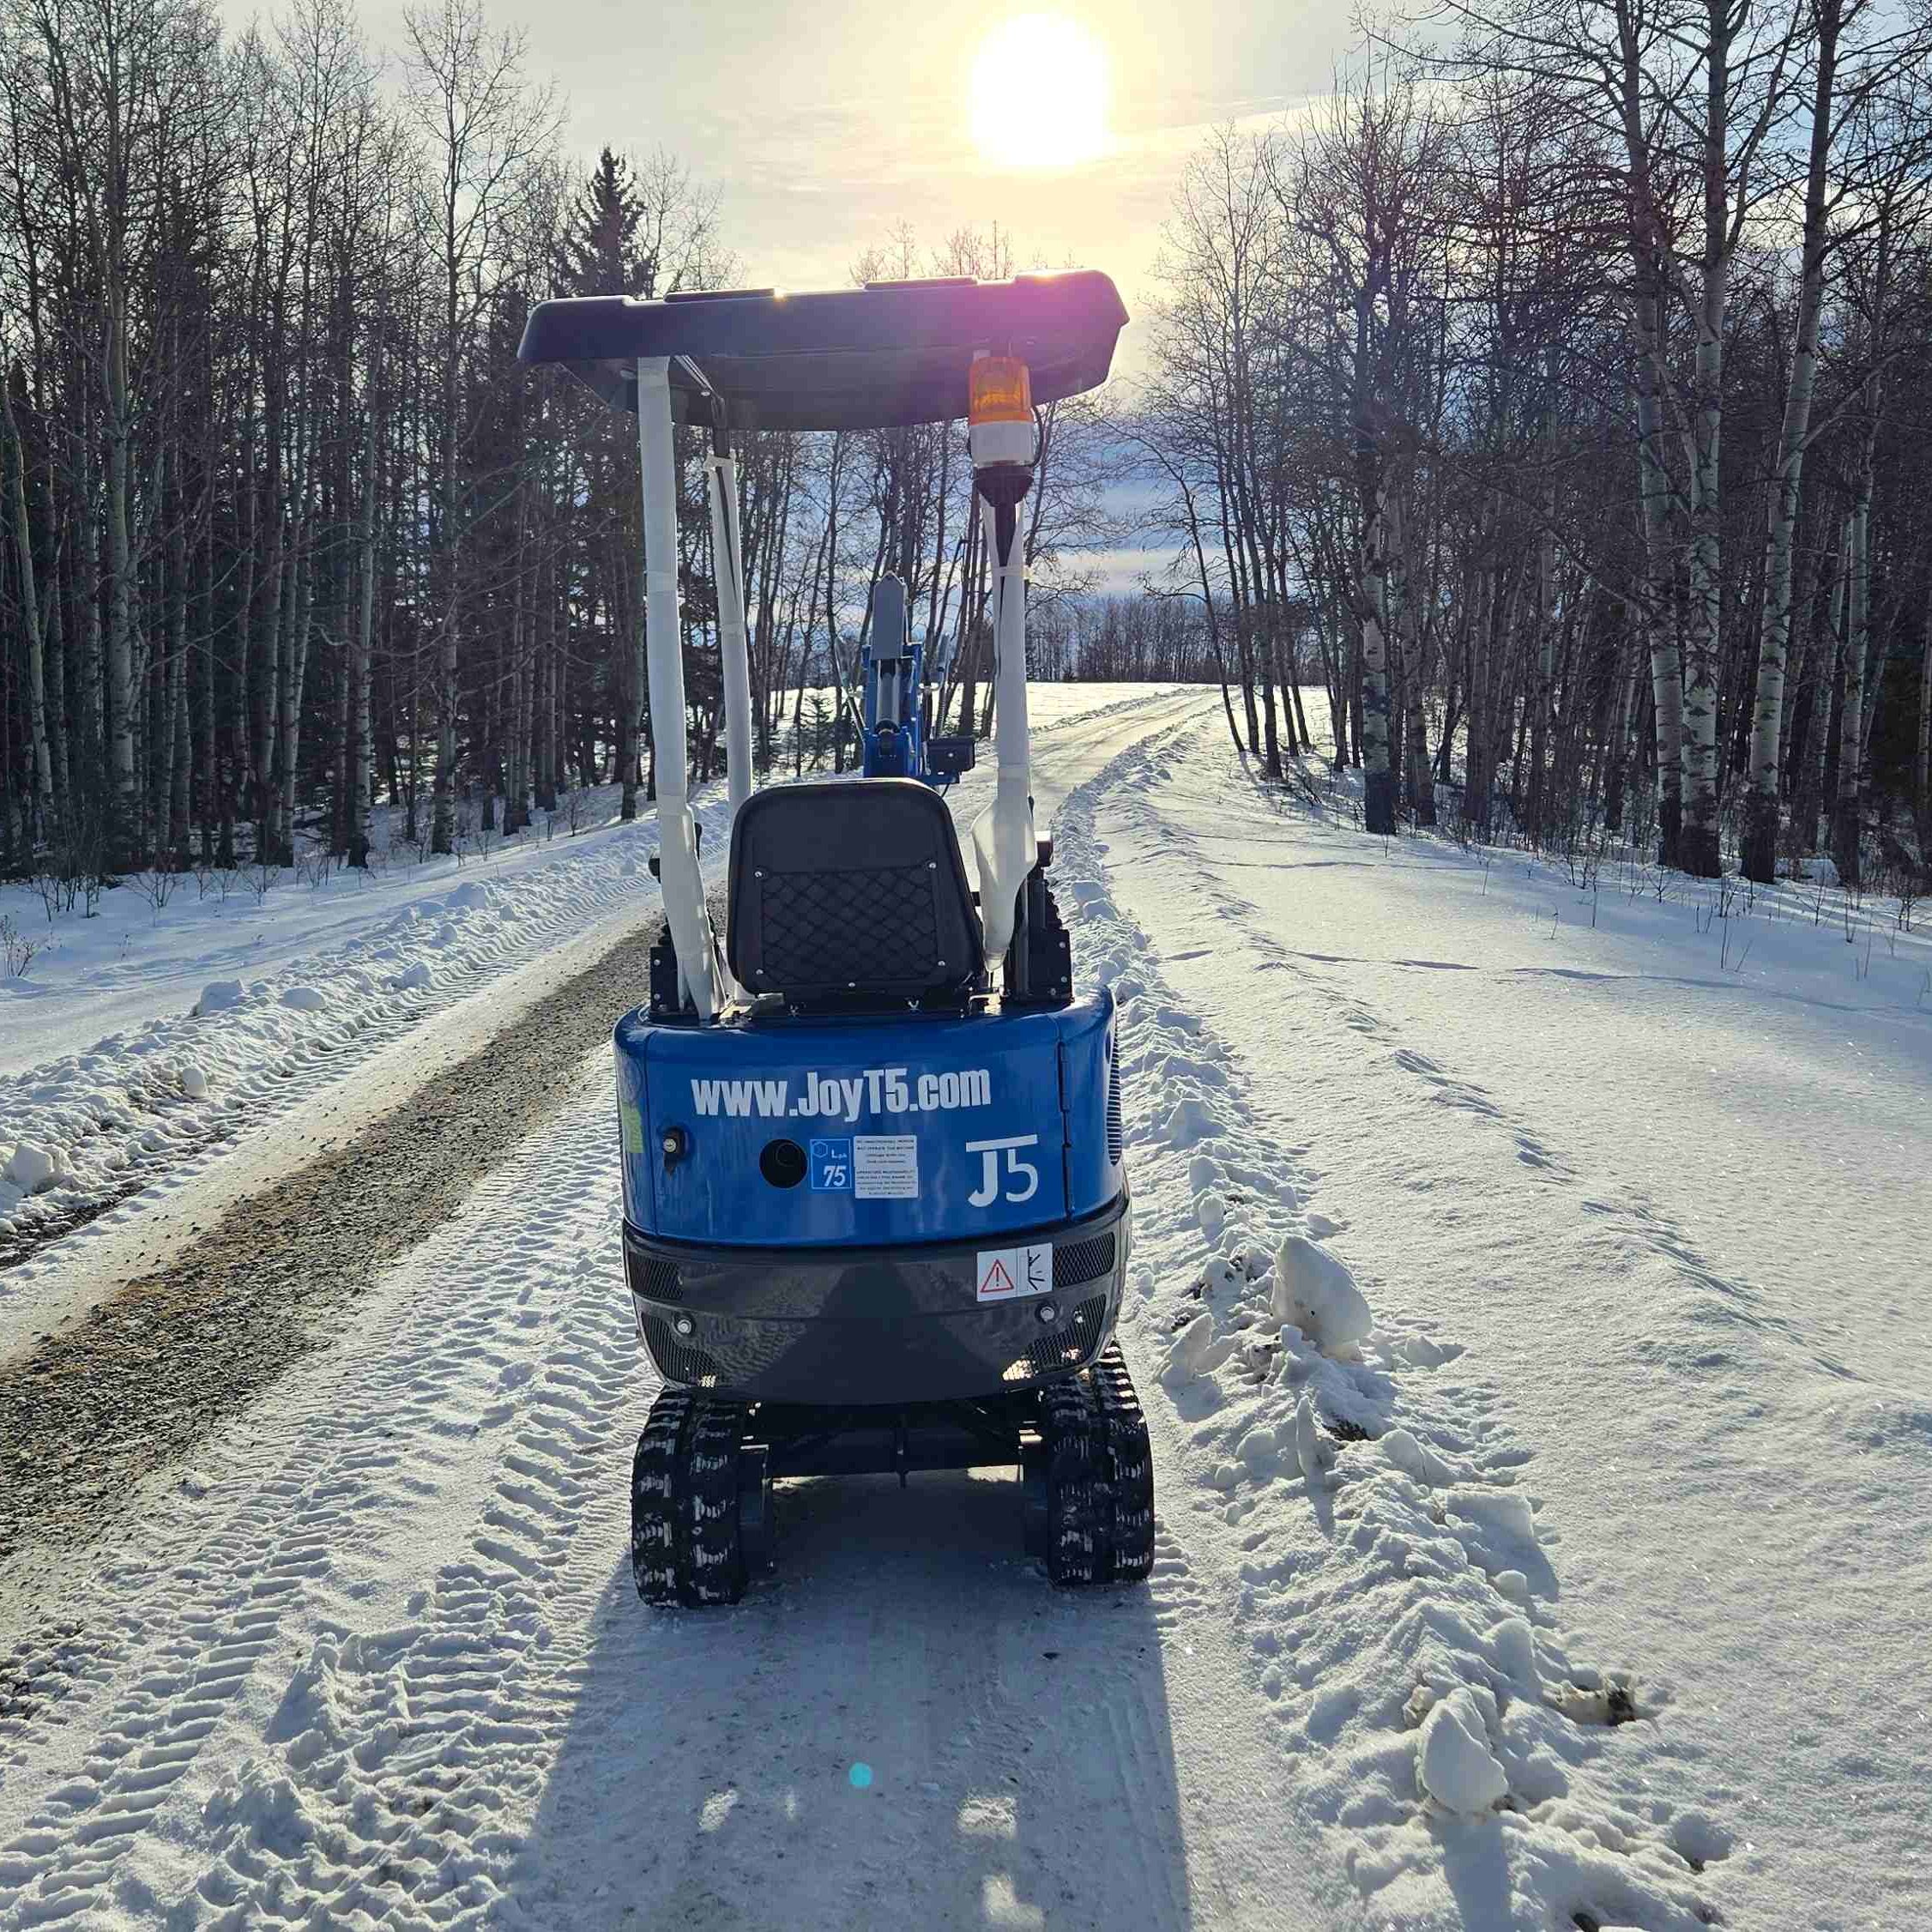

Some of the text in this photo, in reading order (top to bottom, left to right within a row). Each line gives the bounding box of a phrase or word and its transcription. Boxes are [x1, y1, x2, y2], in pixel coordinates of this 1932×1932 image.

[691, 1068, 992, 1122] www.JoyT5.com
[824, 1165, 847, 1186] 75
[966, 1134, 1038, 1207] J5
